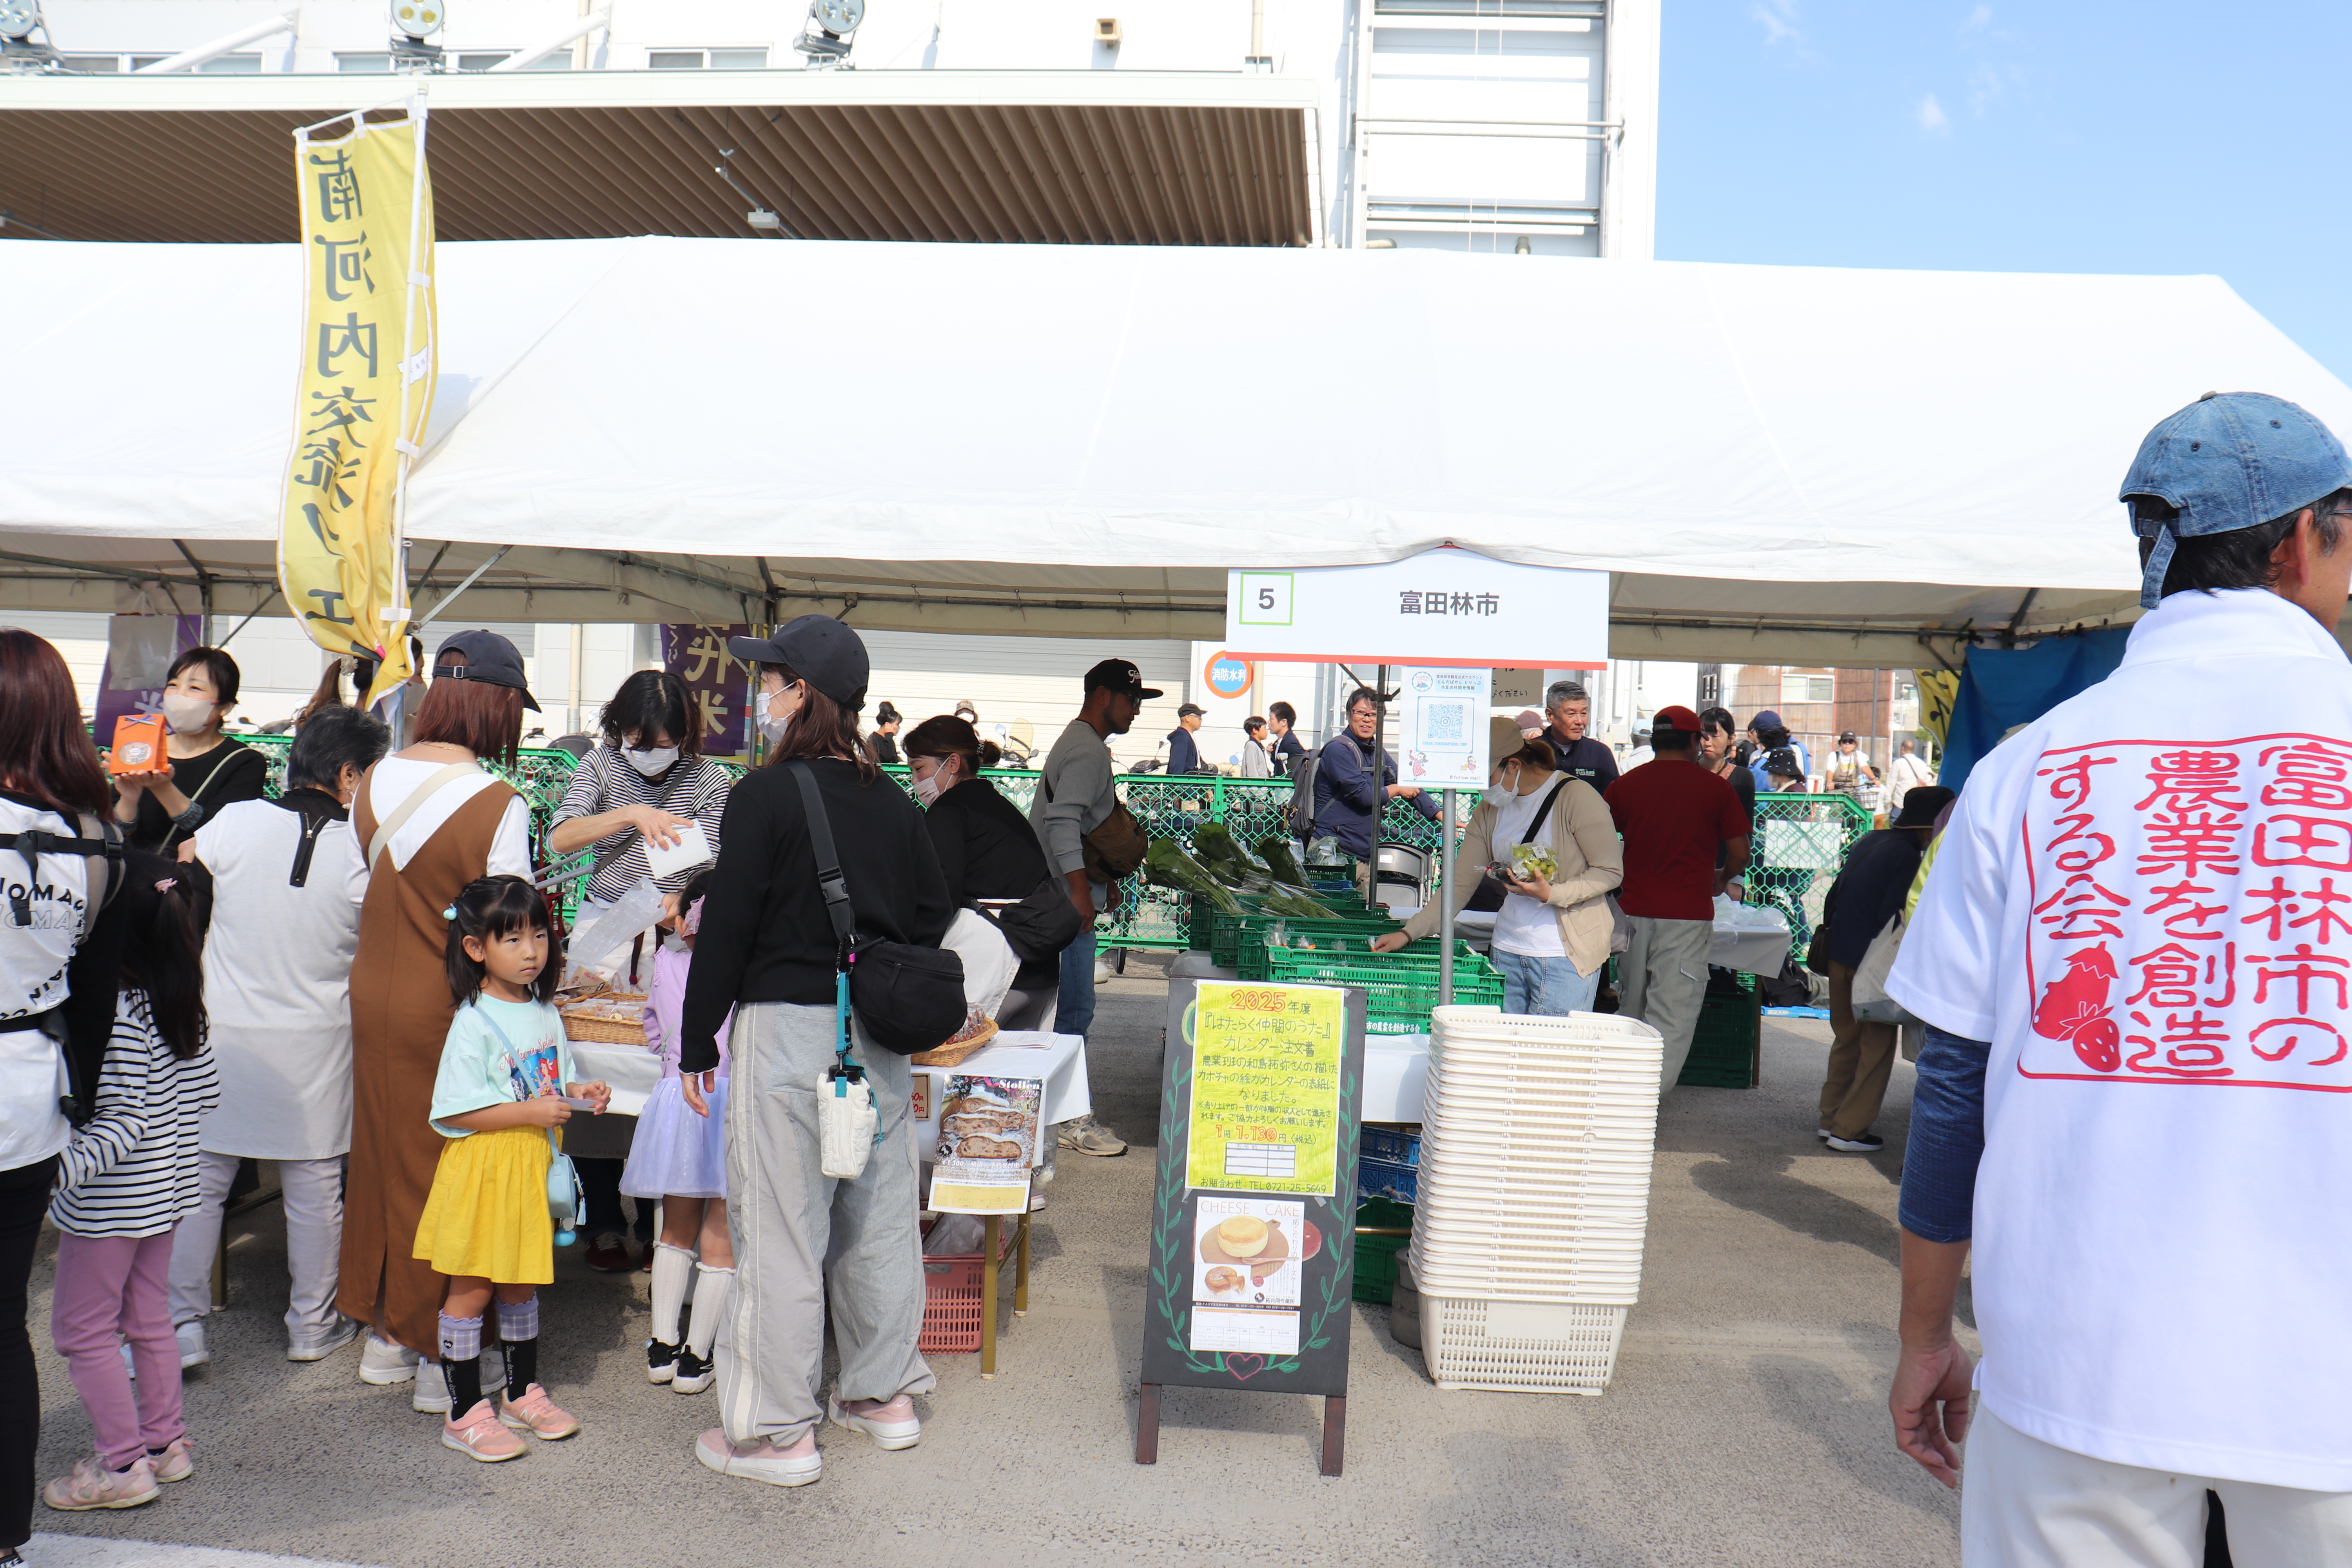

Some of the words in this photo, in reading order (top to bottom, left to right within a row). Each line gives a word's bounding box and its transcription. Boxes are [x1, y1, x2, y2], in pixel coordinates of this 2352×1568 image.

[1258, 588, 1275, 610] 5
[1399, 590, 1500, 616] 富田林市
[1212, 667, 1246, 682] 消防水利
[2033, 754, 2131, 939] する会
[2125, 750, 2249, 1077] 農業を創造
[1229, 989, 1311, 1015] 2025年度
[1205, 1012, 1330, 1039] 『はたらく仲間のうた』
[1366, 1020, 1421, 1034] 市の農業を創造する会
[1223, 1034, 1315, 1057] カレンダー注文書
[998, 1079, 1040, 1090] Stollen
[1239, 1088, 1296, 1104] なりました。
[1201, 1200, 1250, 1214] CHEESE
[1265, 1203, 1299, 1217] CAKE
